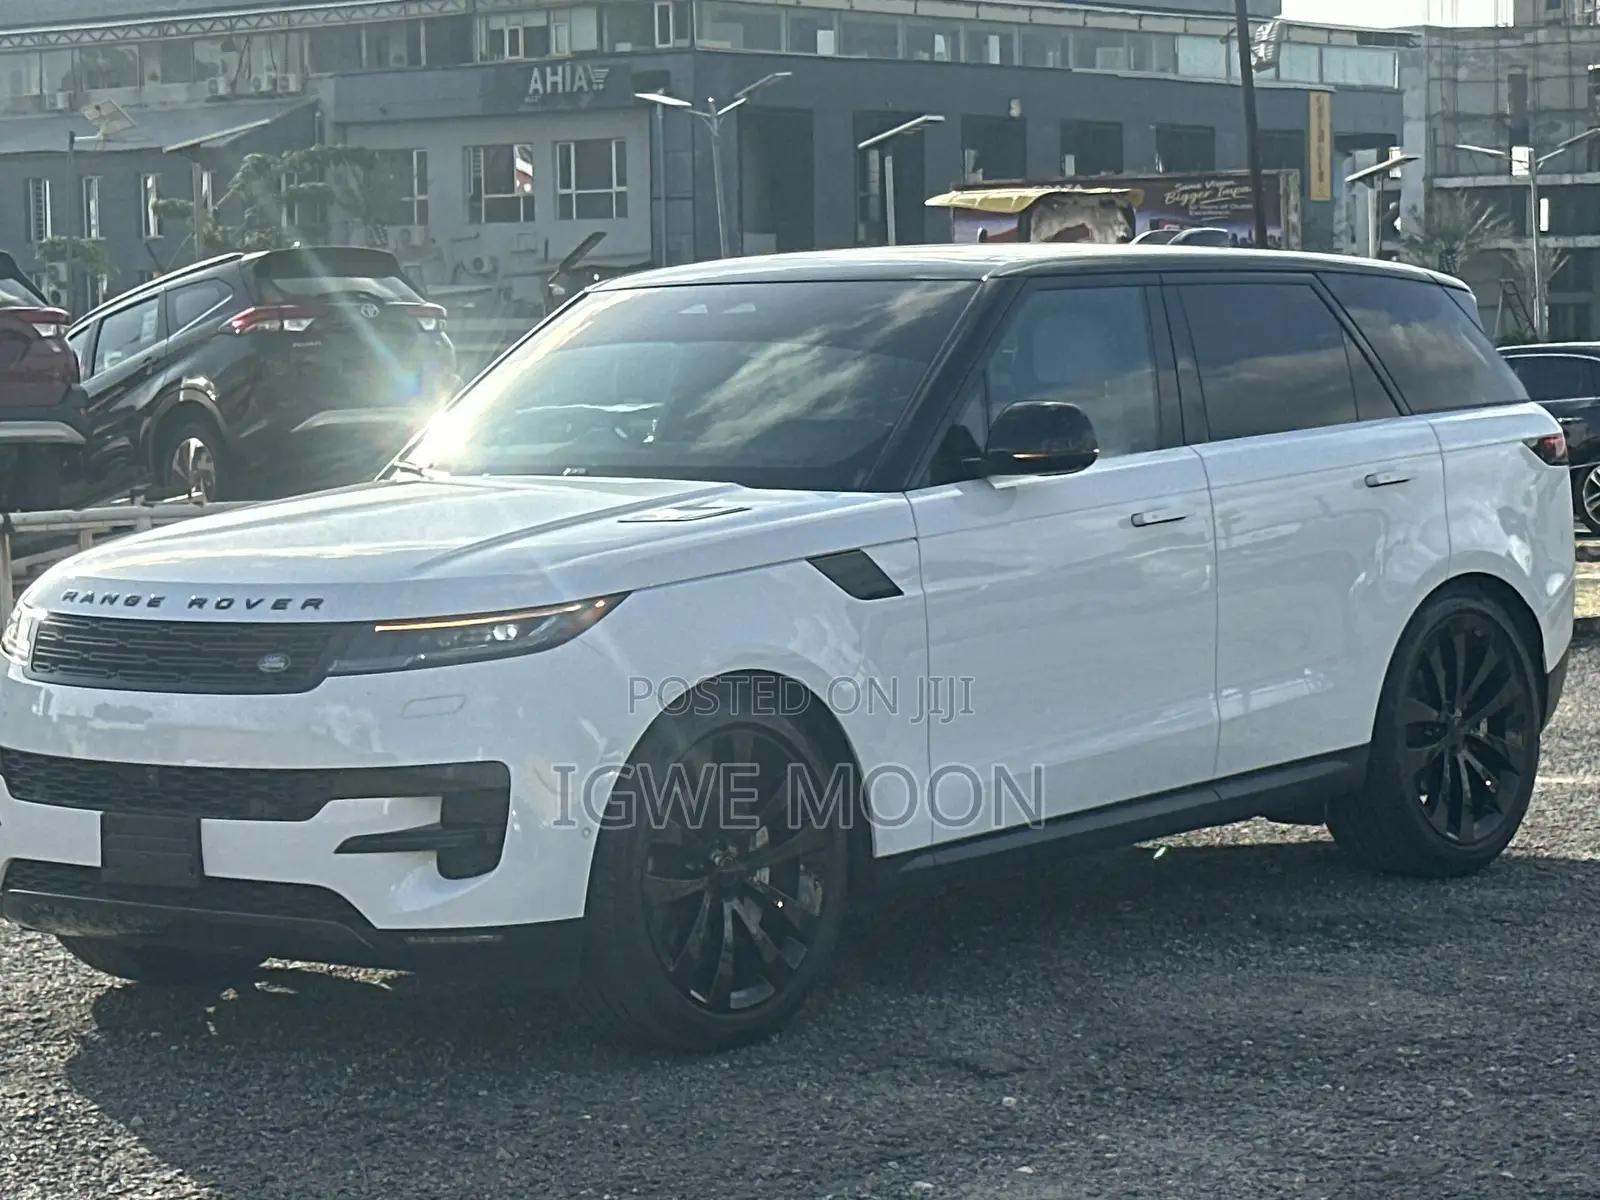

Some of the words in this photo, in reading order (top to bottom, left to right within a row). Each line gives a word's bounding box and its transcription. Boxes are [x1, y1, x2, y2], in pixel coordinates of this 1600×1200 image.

[528, 62, 588, 94] AHIA
[1164, 190, 1212, 206] Bigger
[61, 587, 167, 608] RANGE
[187, 594, 325, 611] ROVER
